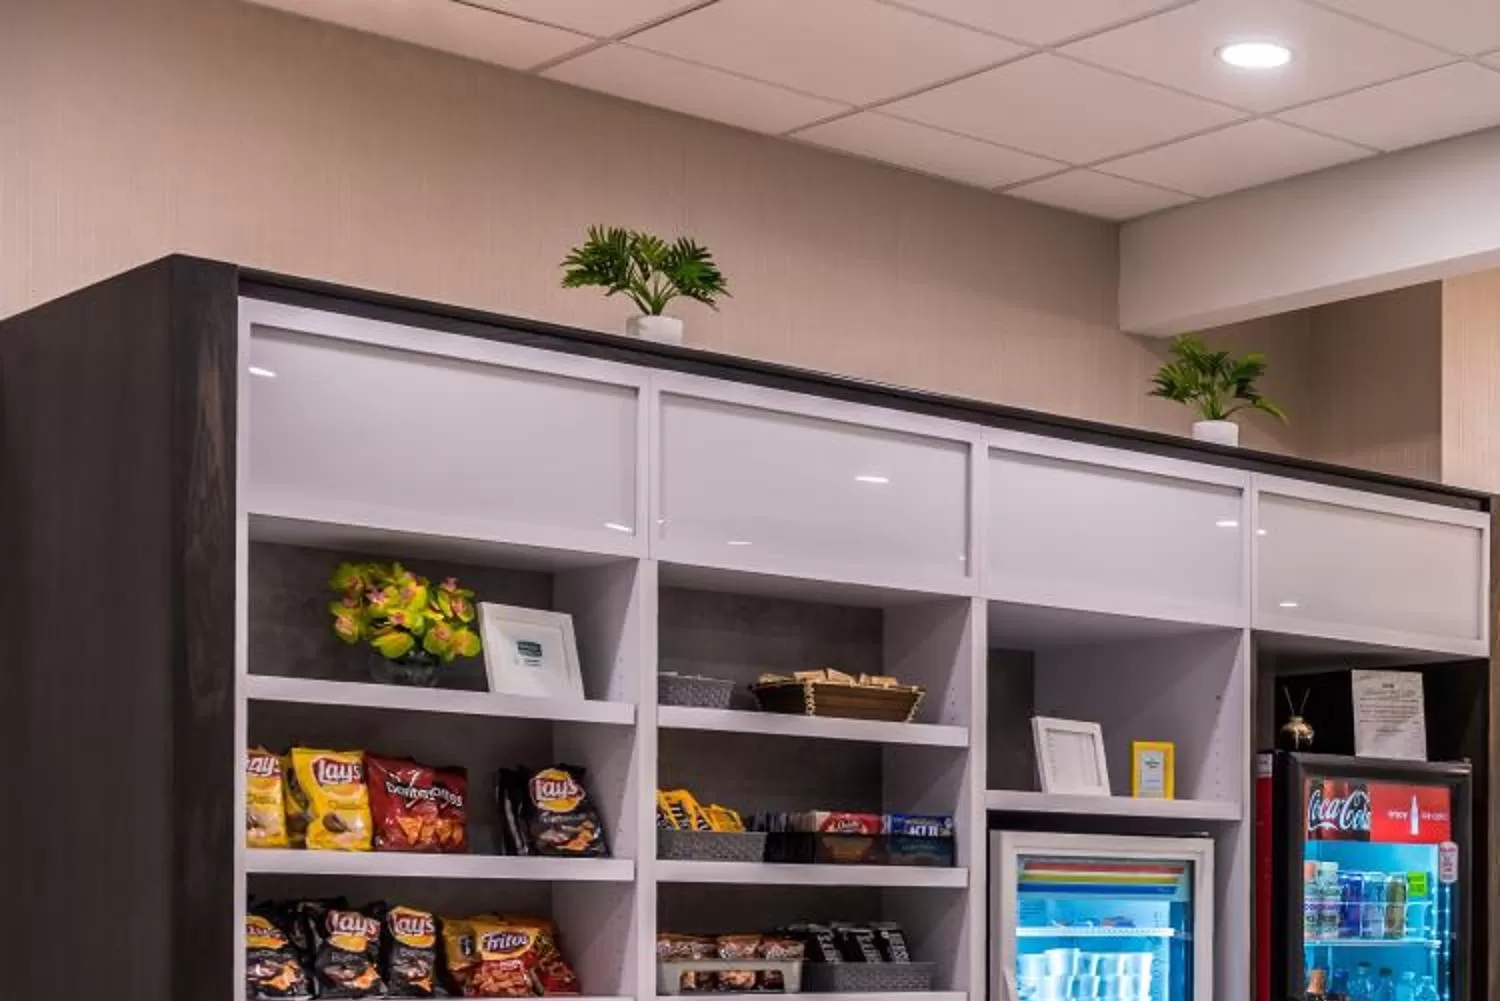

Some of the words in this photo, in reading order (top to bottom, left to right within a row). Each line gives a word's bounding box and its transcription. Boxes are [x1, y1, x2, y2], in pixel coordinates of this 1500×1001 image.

[318, 759, 362, 785] Lay's
[535, 778, 578, 800] Lay's
[483, 930, 528, 950] Fritos
